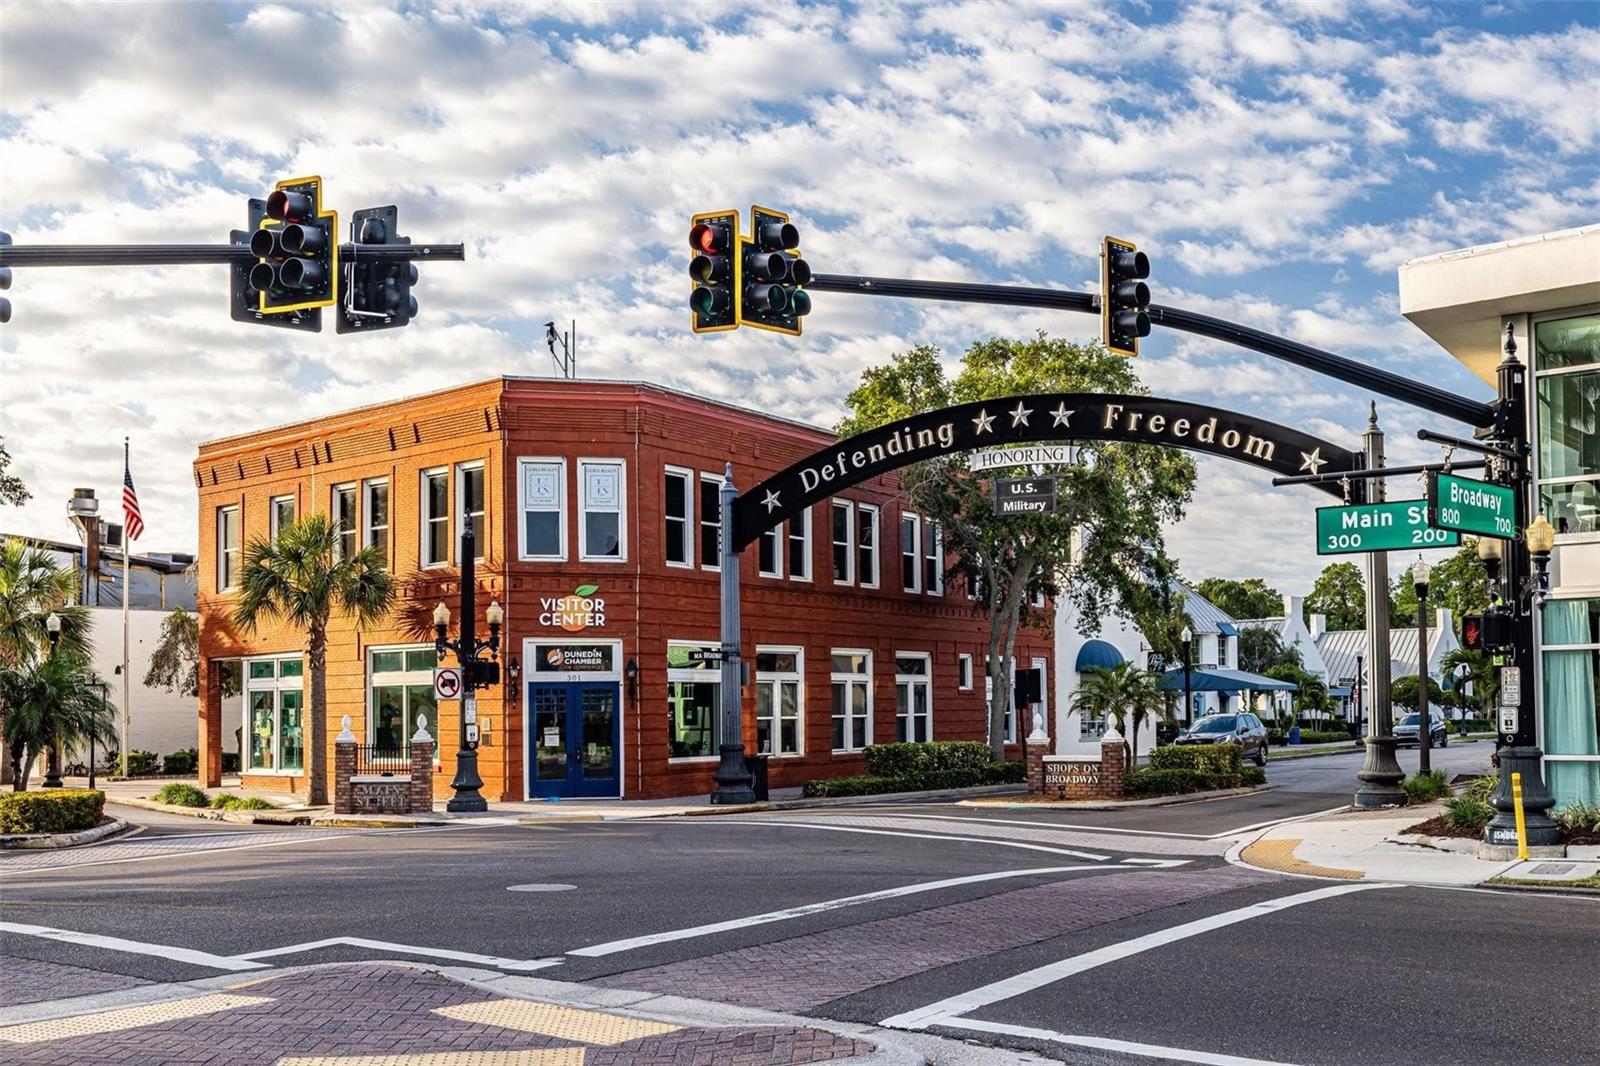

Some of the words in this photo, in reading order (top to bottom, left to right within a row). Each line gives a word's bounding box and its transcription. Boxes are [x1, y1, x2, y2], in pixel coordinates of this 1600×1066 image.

[799, 421, 954, 493] Defending
[1103, 403, 1276, 462] Freedom
[982, 447, 1064, 467] HONORING
[1011, 483, 1038, 494] U.S.
[1450, 482, 1502, 516] Broadway
[1003, 501, 1046, 512] Military
[1341, 510, 1393, 530] Main
[1442, 507, 1460, 525] 800
[1494, 516, 1512, 534] 700
[1328, 534, 1362, 549] 300
[1412, 529, 1447, 544] 200
[540, 598, 605, 612] VISITOR
[539, 613, 606, 627] CENTER
[564, 650, 602, 658] DUNEDIN
[1047, 763, 1079, 773] SHOPS
[1083, 764, 1099, 774] ON
[1045, 775, 1100, 784] BROADWAY
